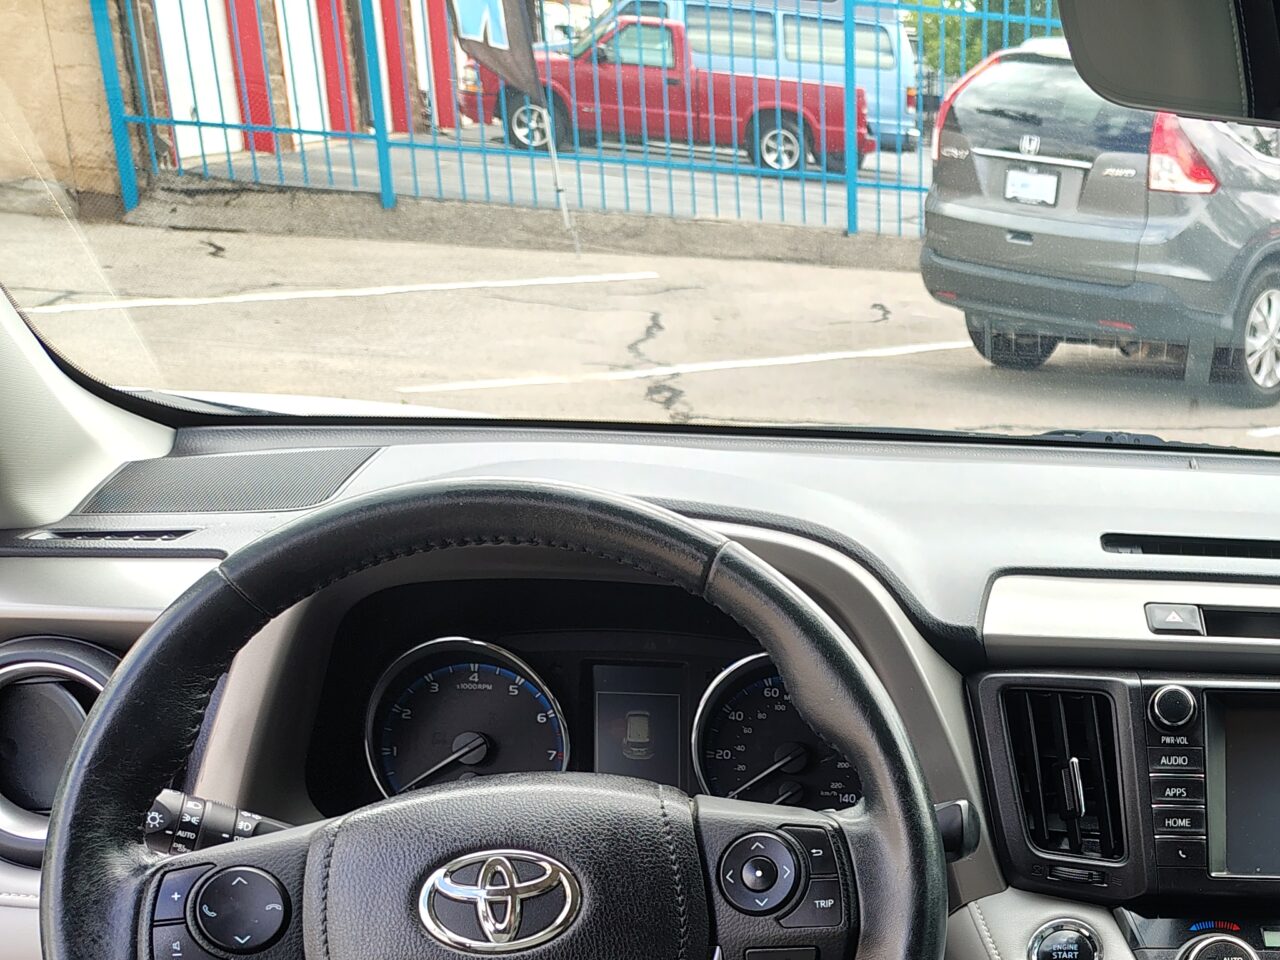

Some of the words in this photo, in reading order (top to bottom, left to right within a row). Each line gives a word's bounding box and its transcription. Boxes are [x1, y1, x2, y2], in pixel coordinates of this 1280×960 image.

[469, 672, 479, 682] 4
[430, 682, 439, 693] 3
[508, 685, 519, 696] 5
[763, 687, 780, 698] 60
[401, 708, 412, 719] 2
[536, 713, 547, 724] 6
[728, 711, 744, 721] 40
[547, 750, 557, 761] 7
[715, 749, 731, 760] 20
[1160, 755, 1189, 765] AUDIO
[1164, 787, 1187, 797] APPS
[838, 793, 856, 804] 140
[1165, 818, 1191, 827] HOME
[176, 830, 196, 840] AUTO
[814, 899, 834, 909] TRIP
[1052, 943, 1079, 951] ENGINE
[1052, 951, 1079, 960] START
